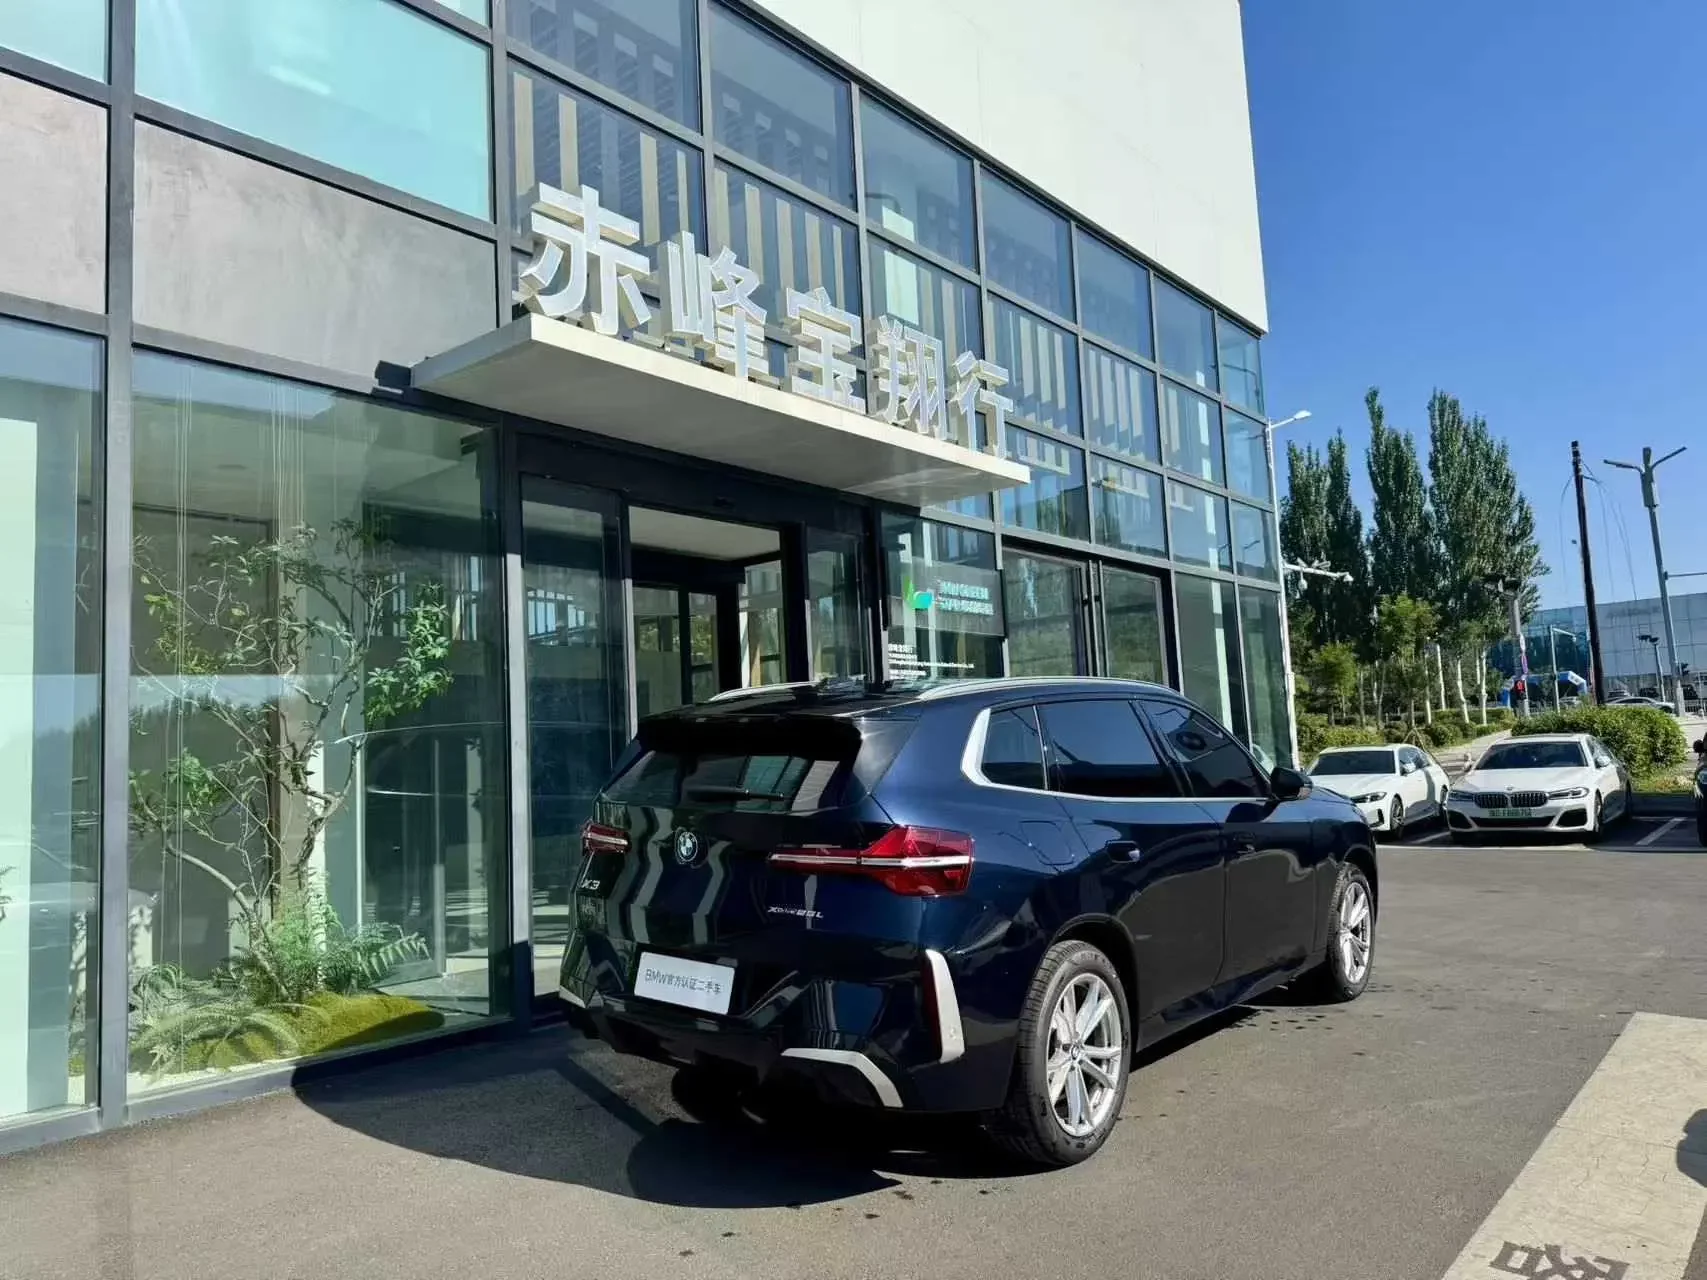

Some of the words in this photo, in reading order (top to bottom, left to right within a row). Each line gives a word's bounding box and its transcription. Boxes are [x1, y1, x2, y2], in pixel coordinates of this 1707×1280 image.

[518, 183, 1014, 460] 赤峰宝翔行
[580, 879, 600, 890] X3
[644, 967, 722, 995] BMW官方认证二手车
